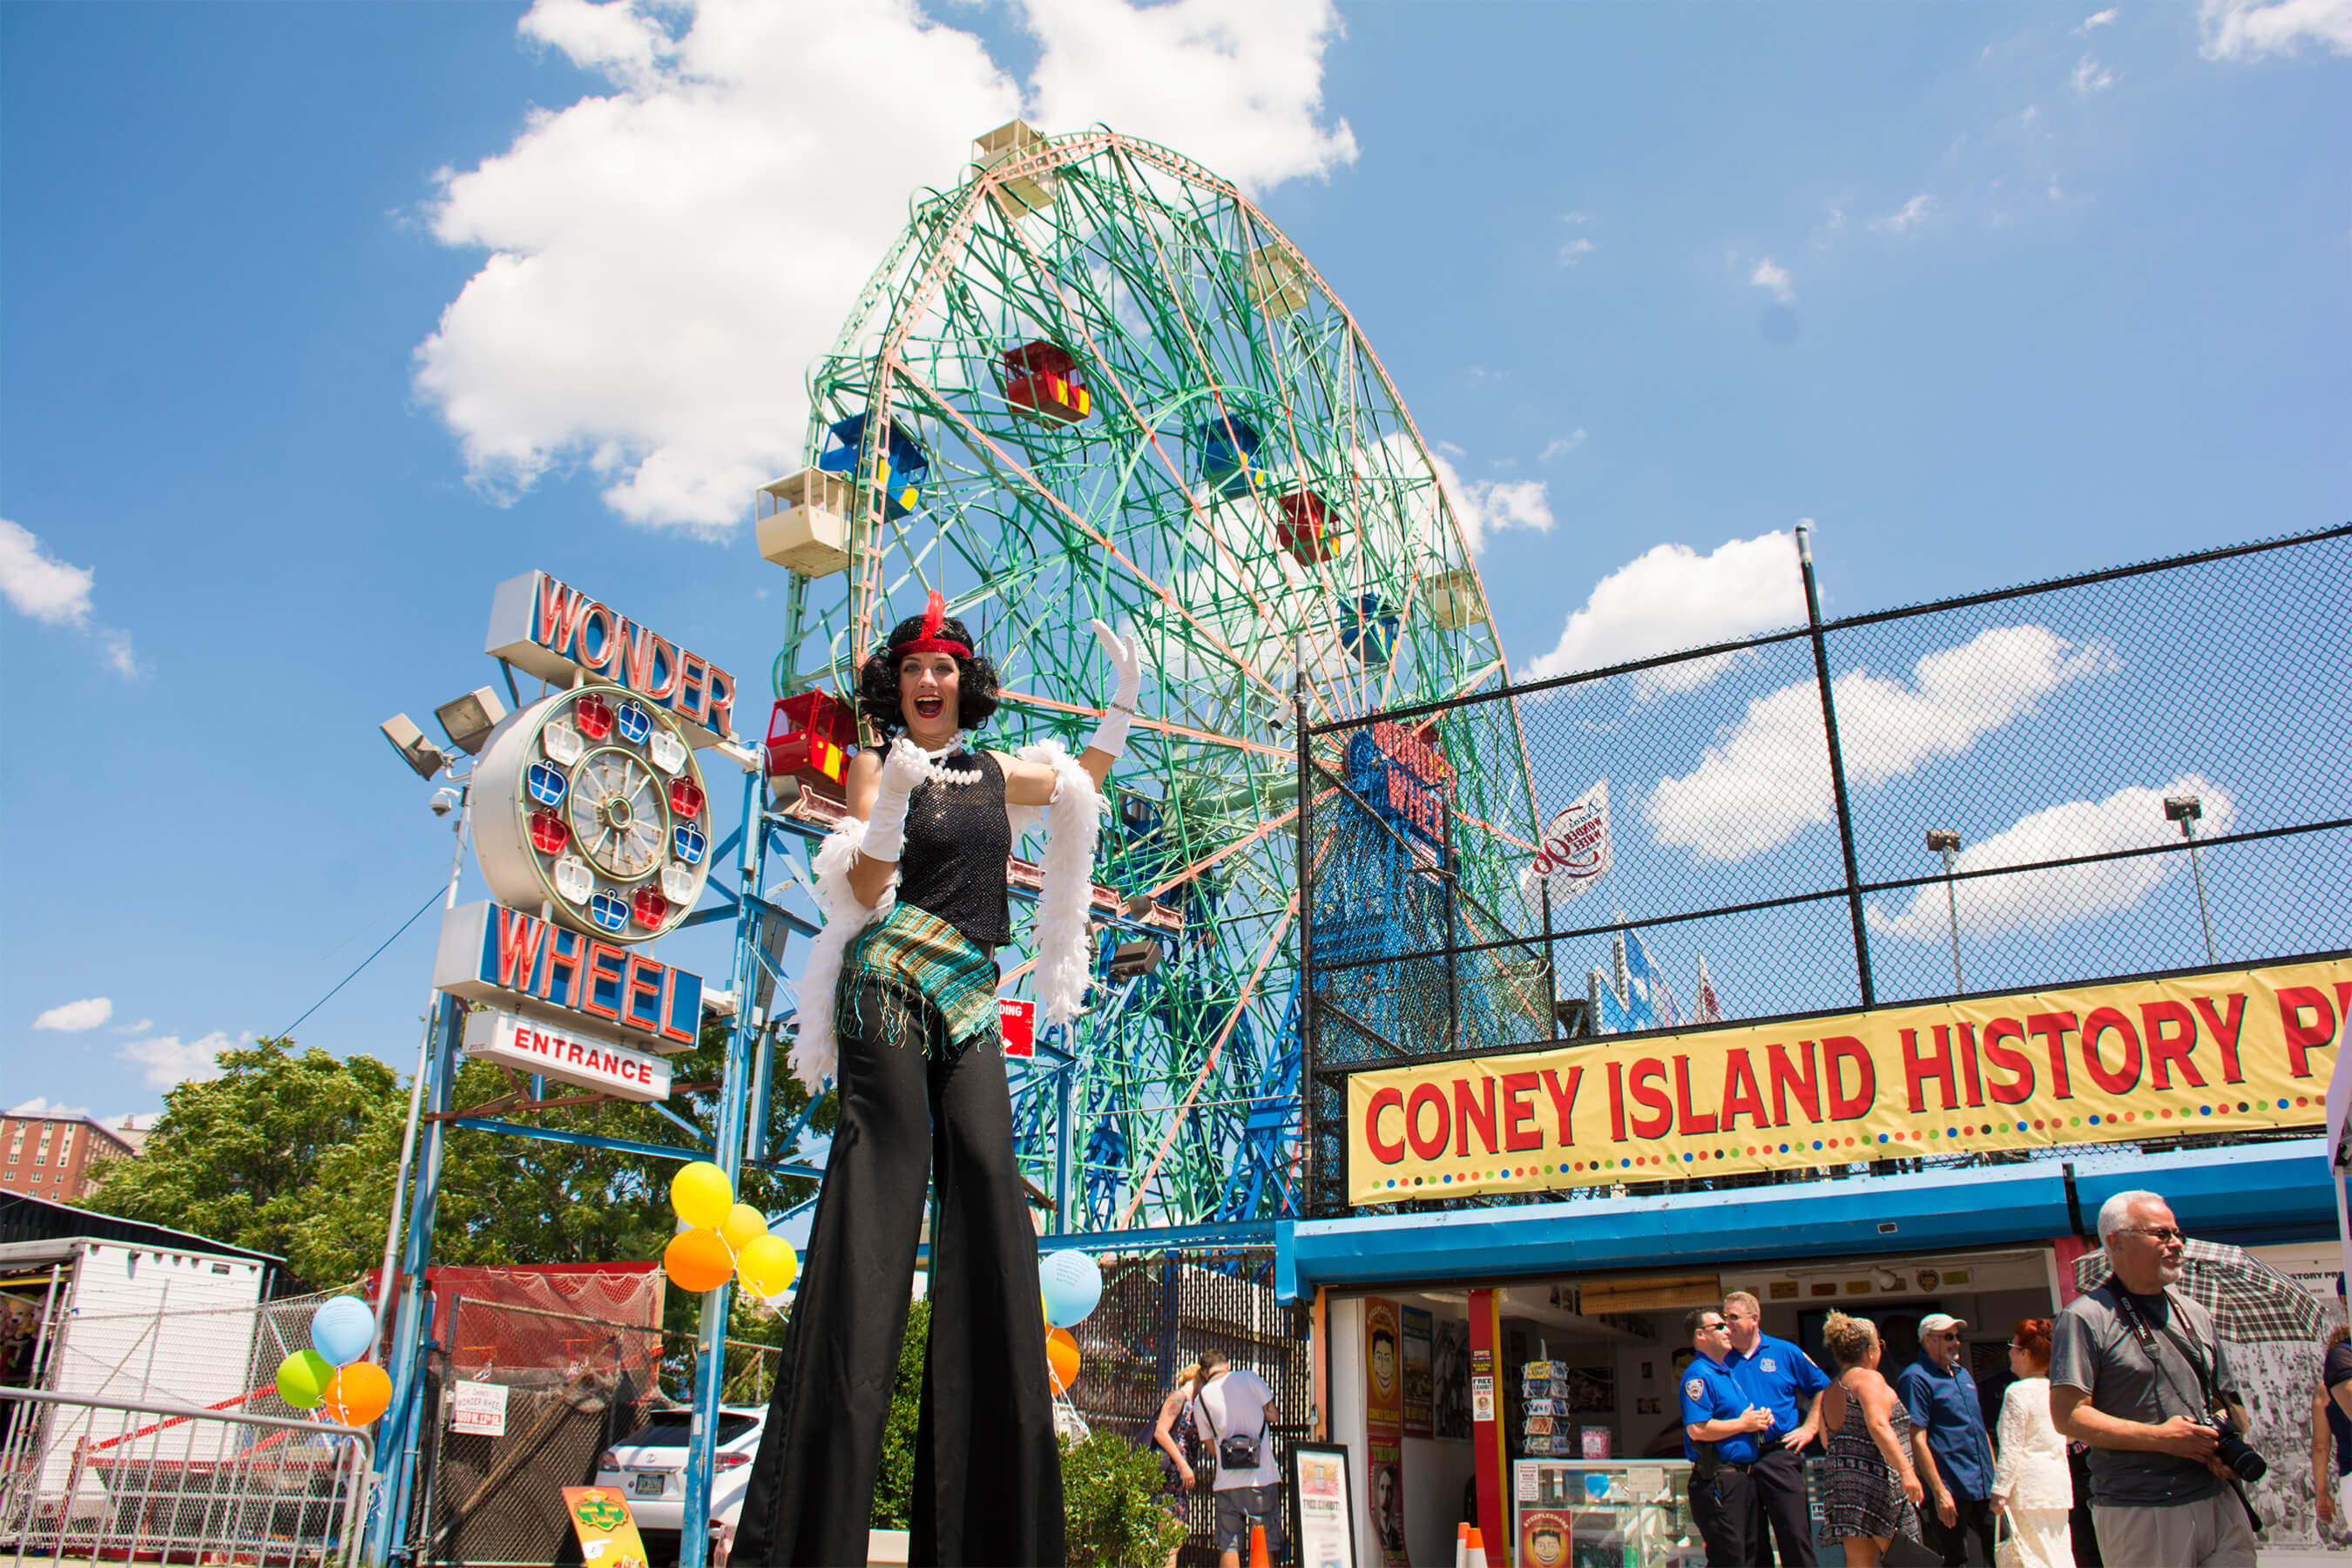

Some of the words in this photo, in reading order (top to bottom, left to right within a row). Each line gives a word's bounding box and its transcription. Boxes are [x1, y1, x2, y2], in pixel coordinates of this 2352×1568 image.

[538, 571, 735, 738] WONDER
[497, 905, 695, 1045] WHEEL
[514, 1027, 652, 1085] ENTRANCE
[1366, 1065, 1585, 1166] CONEY
[1605, 1036, 1876, 1142] ISLAND
[1899, 992, 2248, 1114] HISTORY
